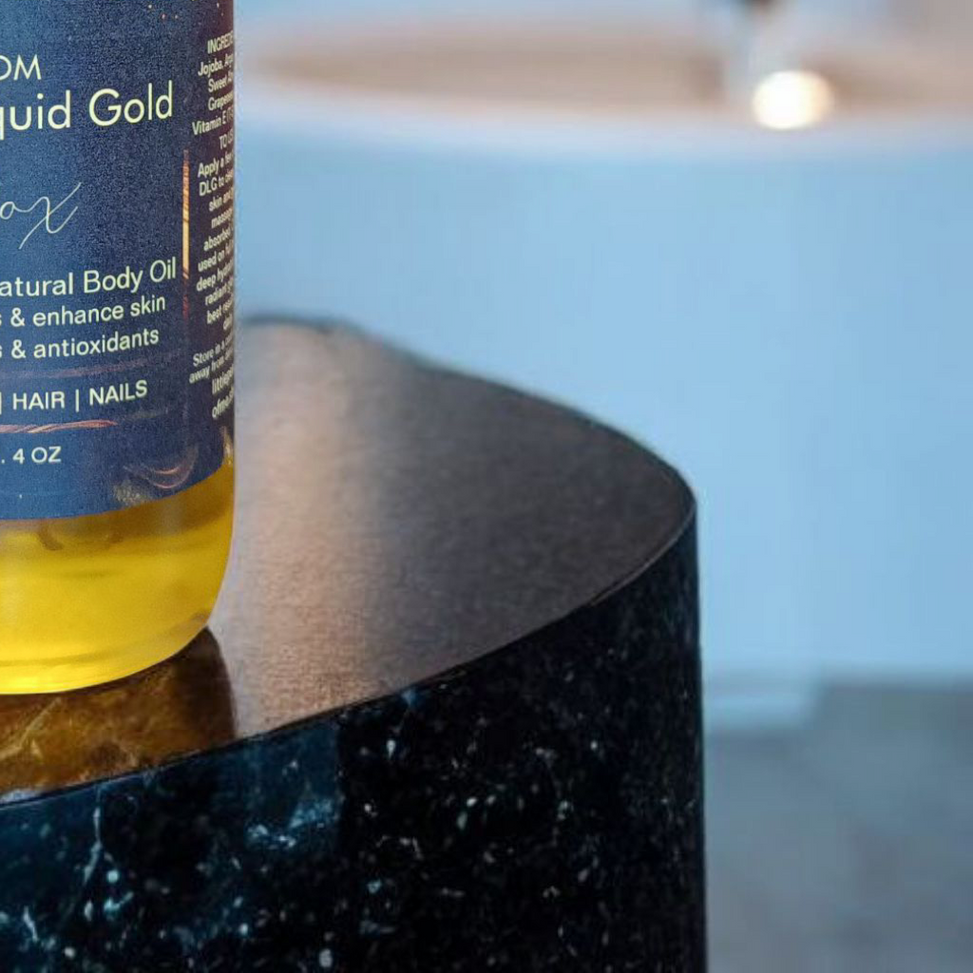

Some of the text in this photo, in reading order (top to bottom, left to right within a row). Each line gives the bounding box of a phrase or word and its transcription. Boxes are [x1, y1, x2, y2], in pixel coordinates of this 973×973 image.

[88, 79, 174, 127] Gold
[192, 115, 222, 136] Vitamin
[198, 158, 220, 179] Apply
[199, 177, 217, 197] DLG
[208, 195, 222, 213] skin
[198, 251, 217, 272] used
[83, 266, 144, 294] Body
[149, 256, 177, 283] Oil
[196, 274, 216, 292] deep
[10, 307, 26, 327] &
[32, 301, 125, 327] enhance
[130, 294, 167, 318] skin
[11, 339, 27, 359] &
[33, 326, 160, 359] antioxidants
[193, 348, 214, 367] Store
[189, 365, 210, 385] away
[12, 389, 65, 410] HAIR
[89, 380, 148, 407] NAILS
[12, 447, 25, 464] 4
[31, 446, 62, 464] OZ
